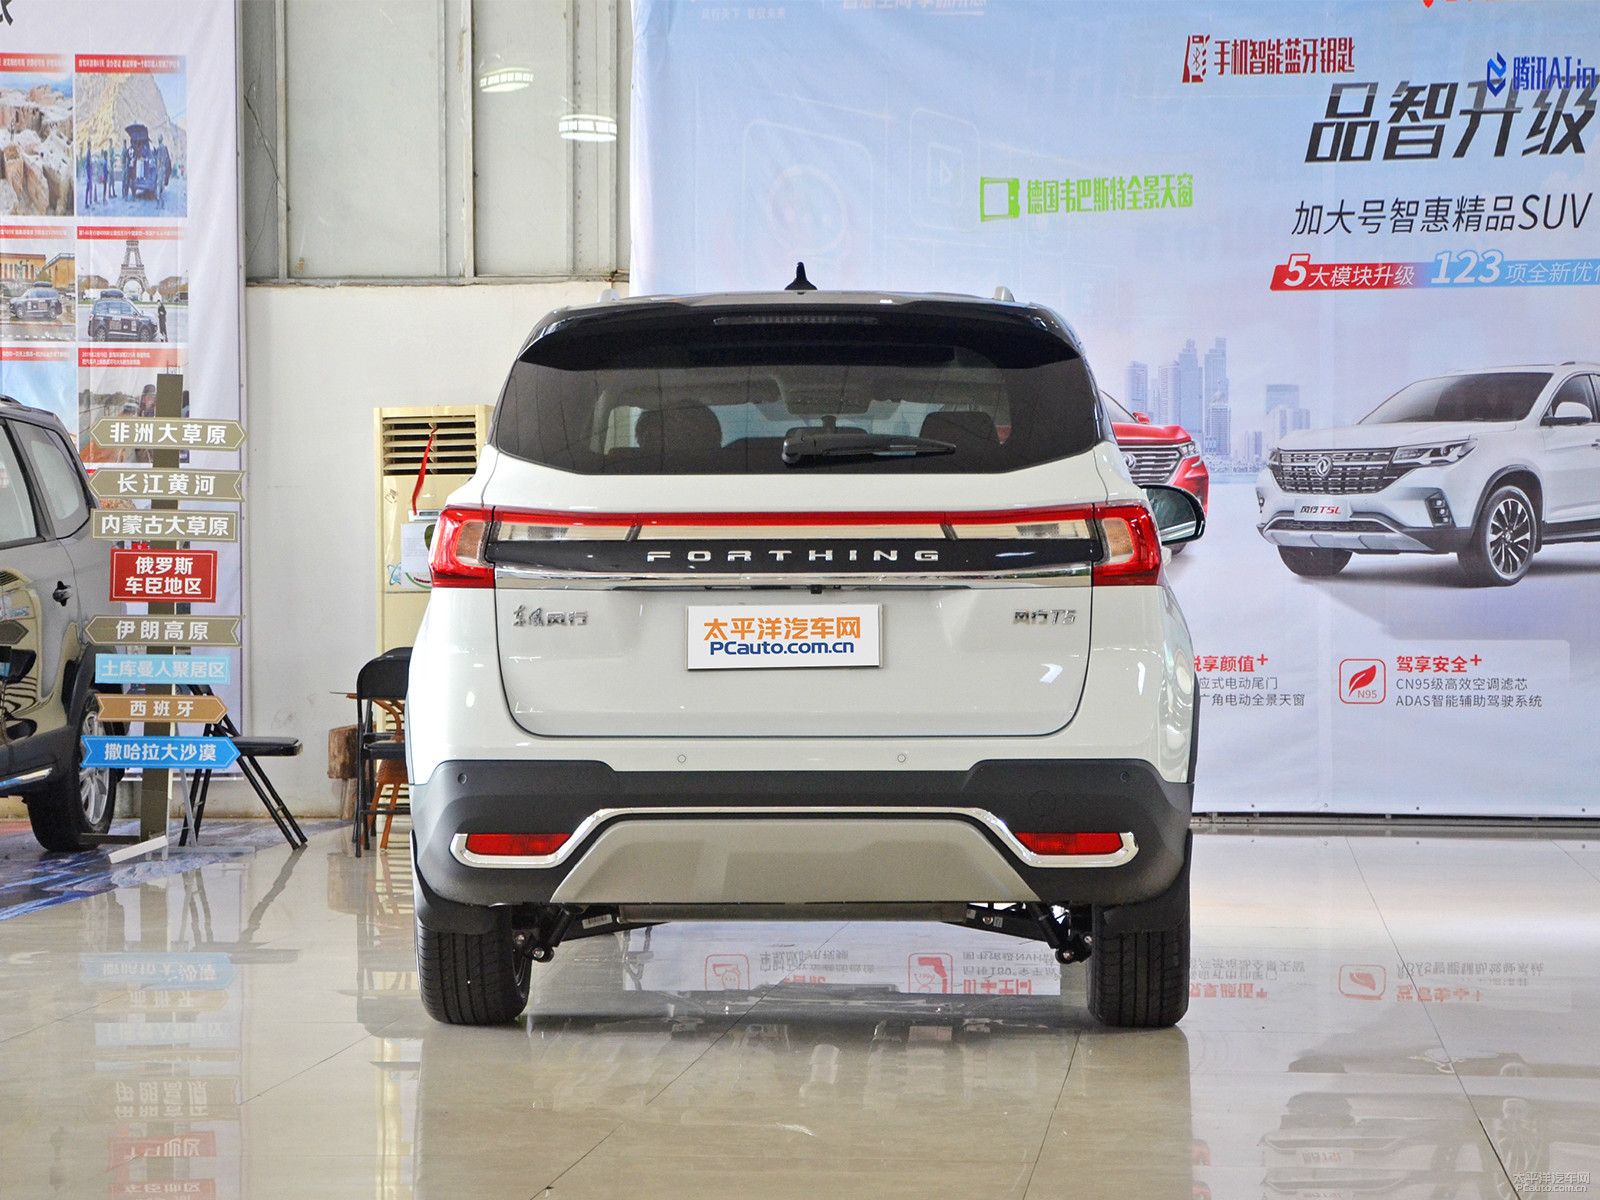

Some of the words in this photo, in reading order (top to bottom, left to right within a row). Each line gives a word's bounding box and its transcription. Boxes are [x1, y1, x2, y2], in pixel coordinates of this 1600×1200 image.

[1213, 37, 1356, 76] 手机智能蓝牙钥匙
[1304, 74, 1600, 163] 品智升级
[1026, 174, 1194, 215] 德国韦巴斯特全景天窗
[1290, 192, 1593, 236] 加大号智惠精品SUV
[109, 423, 227, 444] 非洲大草原
[117, 473, 216, 495] 长江黄河
[101, 514, 229, 536] 内蒙古大草原
[135, 556, 193, 575] 俄罗斯
[646, 550, 940, 563] FORTHING
[125, 576, 202, 595] 车臣地区
[115, 620, 209, 641] 伊朗高原
[703, 616, 862, 641] 太平洋汽车网
[709, 640, 855, 656] PCauto.com.cn
[102, 660, 226, 679] 土库曼人聚居区
[1396, 678, 1528, 691] CN95级高效空调滤芯
[1357, 690, 1378, 699] N95
[1395, 695, 1543, 708] ADAS智能辅助驾驶系统
[130, 700, 194, 717] 西班牙
[104, 743, 217, 762] 撒哈拉大沙漠
